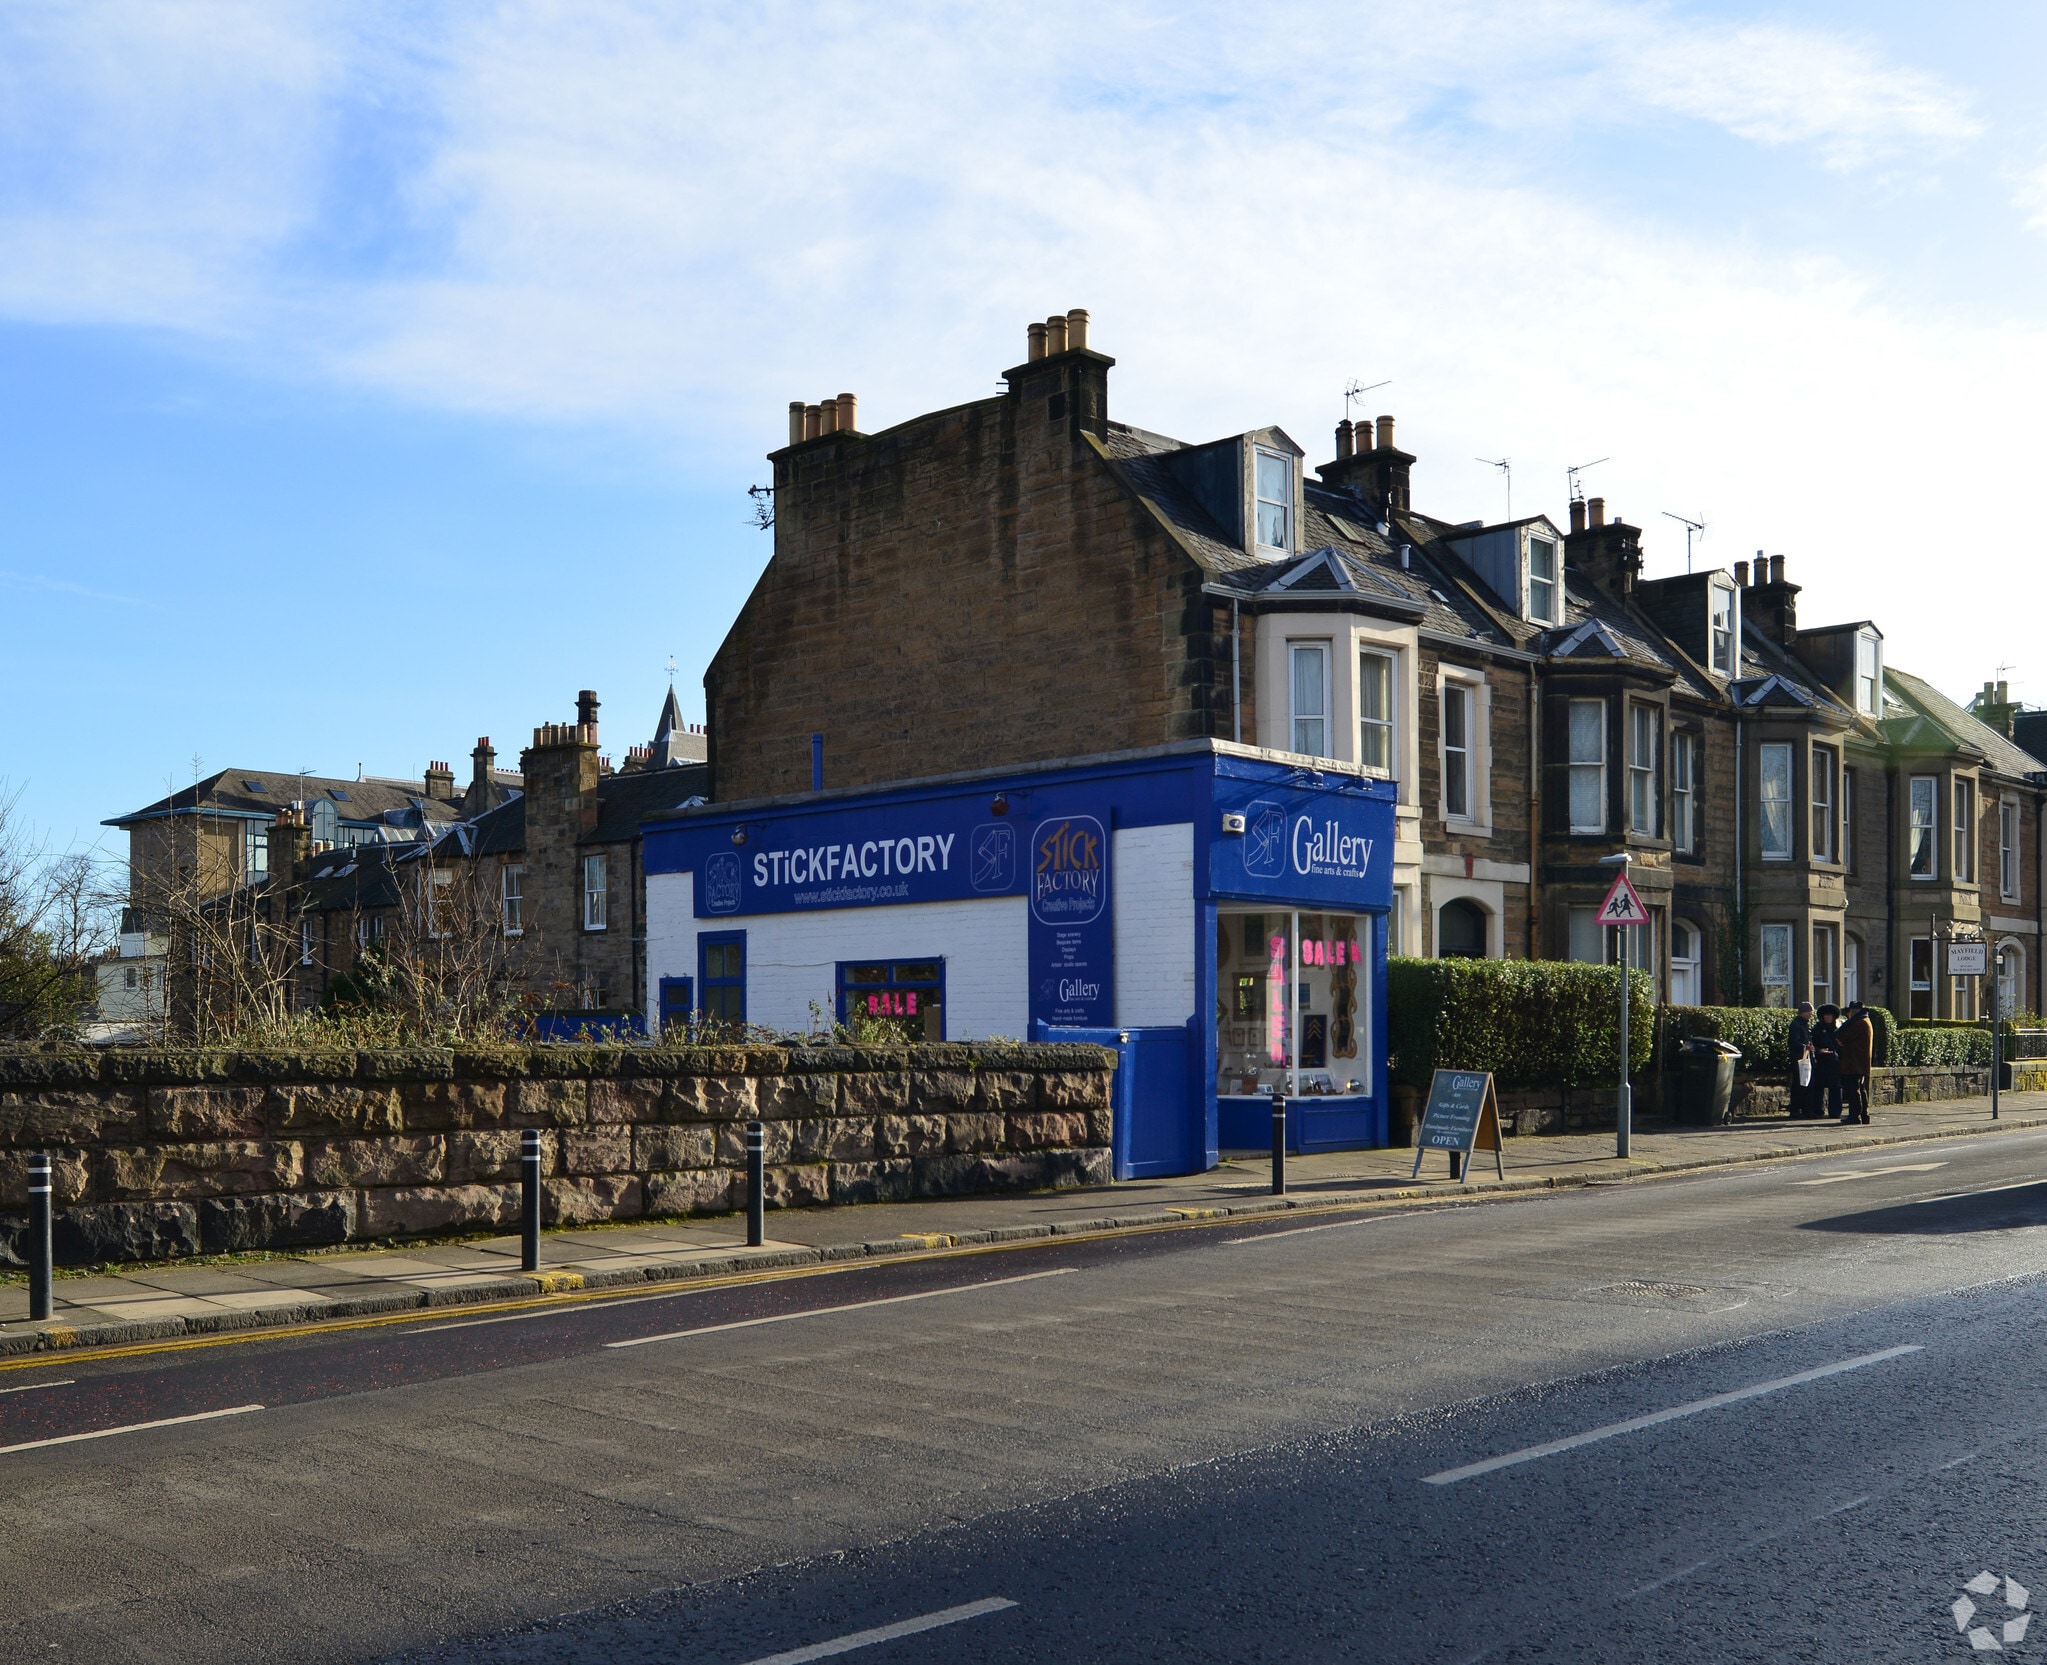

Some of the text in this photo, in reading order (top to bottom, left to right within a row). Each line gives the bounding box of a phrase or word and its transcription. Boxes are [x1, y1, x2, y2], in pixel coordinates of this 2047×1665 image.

[1292, 815, 1373, 878] Gallery
[1311, 864, 1323, 874] fine
[1323, 867, 1335, 876] arts
[1336, 867, 1342, 876] &
[794, 881, 909, 904] www.stickfactory.co.uk
[1036, 869, 1100, 902] FACTORY
[1302, 939, 1346, 966] SALE
[1951, 947, 1983, 955] MAYFIELD
[1059, 978, 1100, 1002] Gallery
[868, 992, 917, 1016] SALE
[1452, 1075, 1481, 1091] Gallery
[1432, 1135, 1460, 1146] OPEN
